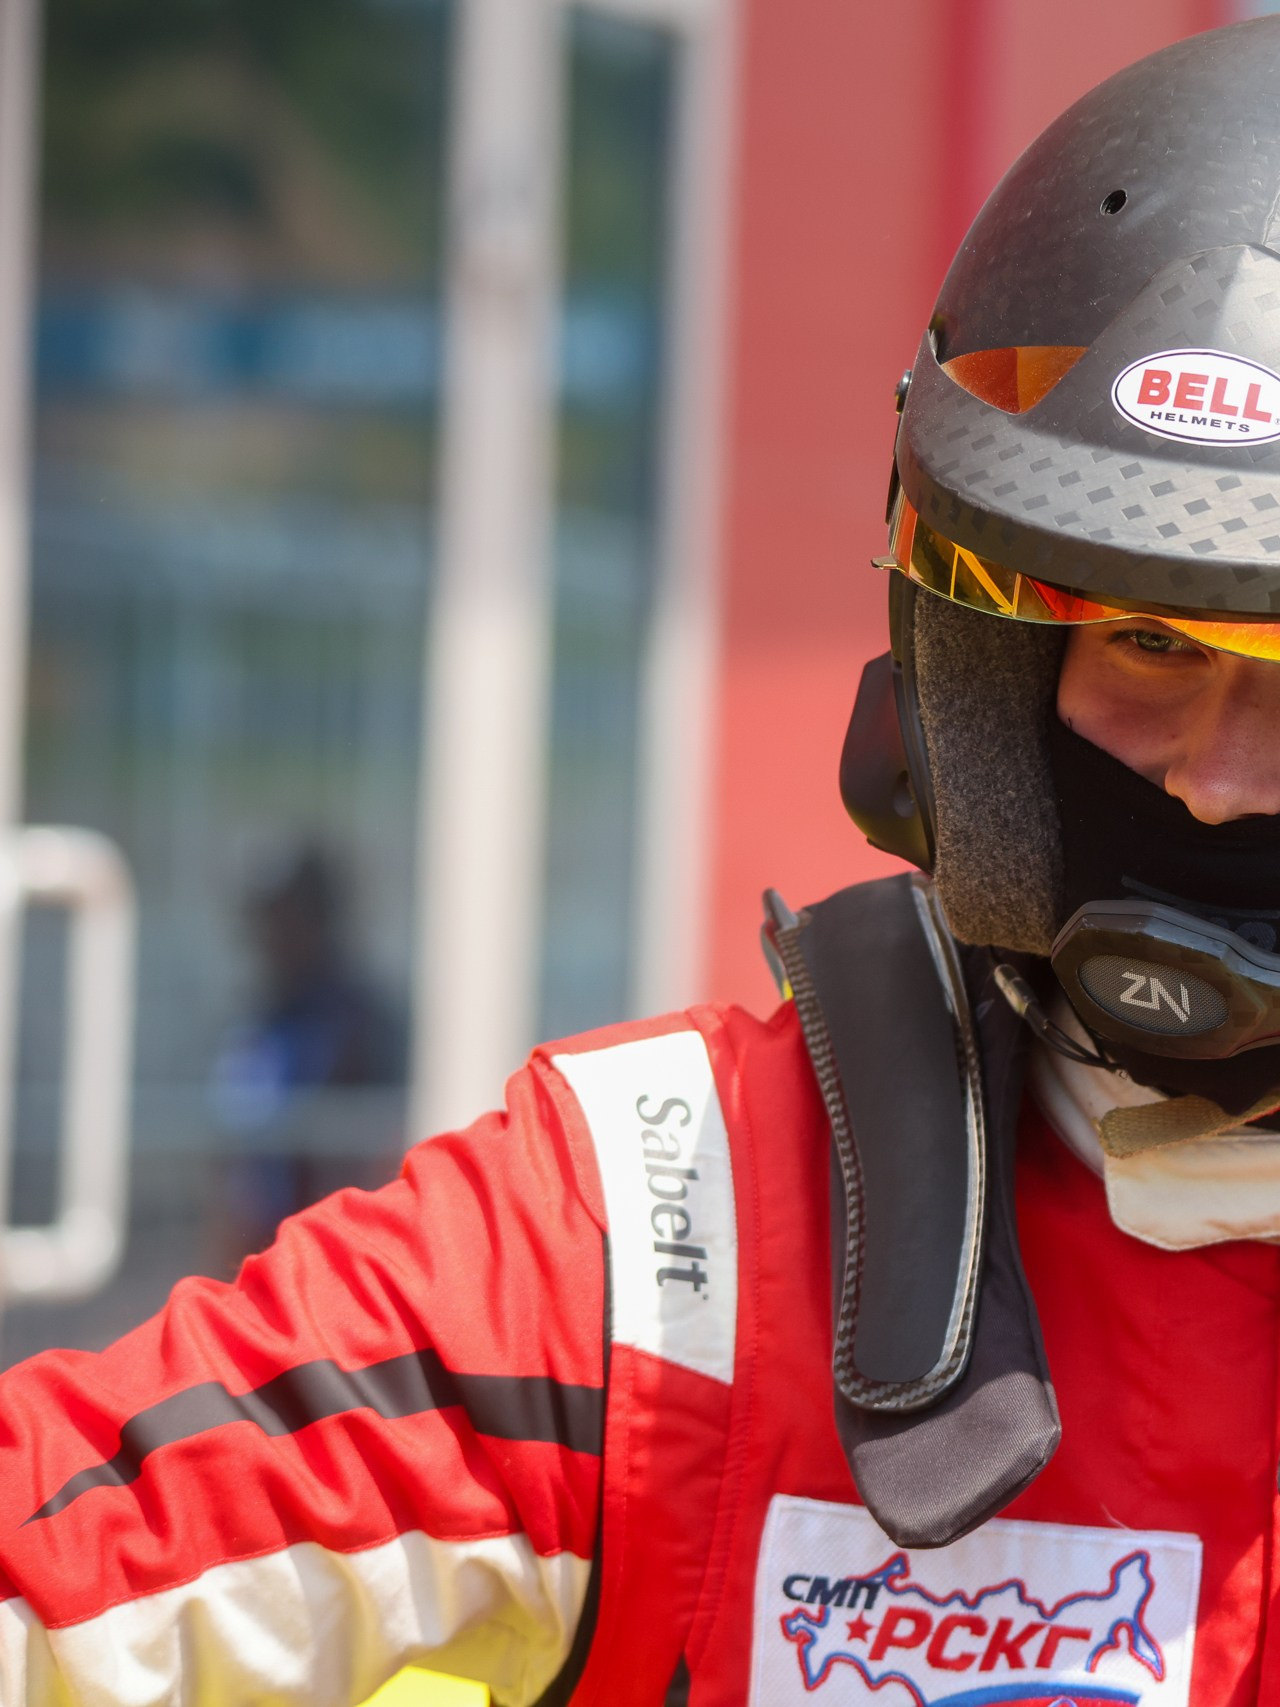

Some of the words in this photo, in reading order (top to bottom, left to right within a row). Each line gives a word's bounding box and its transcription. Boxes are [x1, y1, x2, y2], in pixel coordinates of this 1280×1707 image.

[1137, 369, 1272, 423] BELL
[1150, 411, 1250, 433] HELMETS
[636, 1094, 709, 1292] Sabelt
[783, 1575, 883, 1610] СМП
[868, 1605, 1092, 1672] РСКГ
